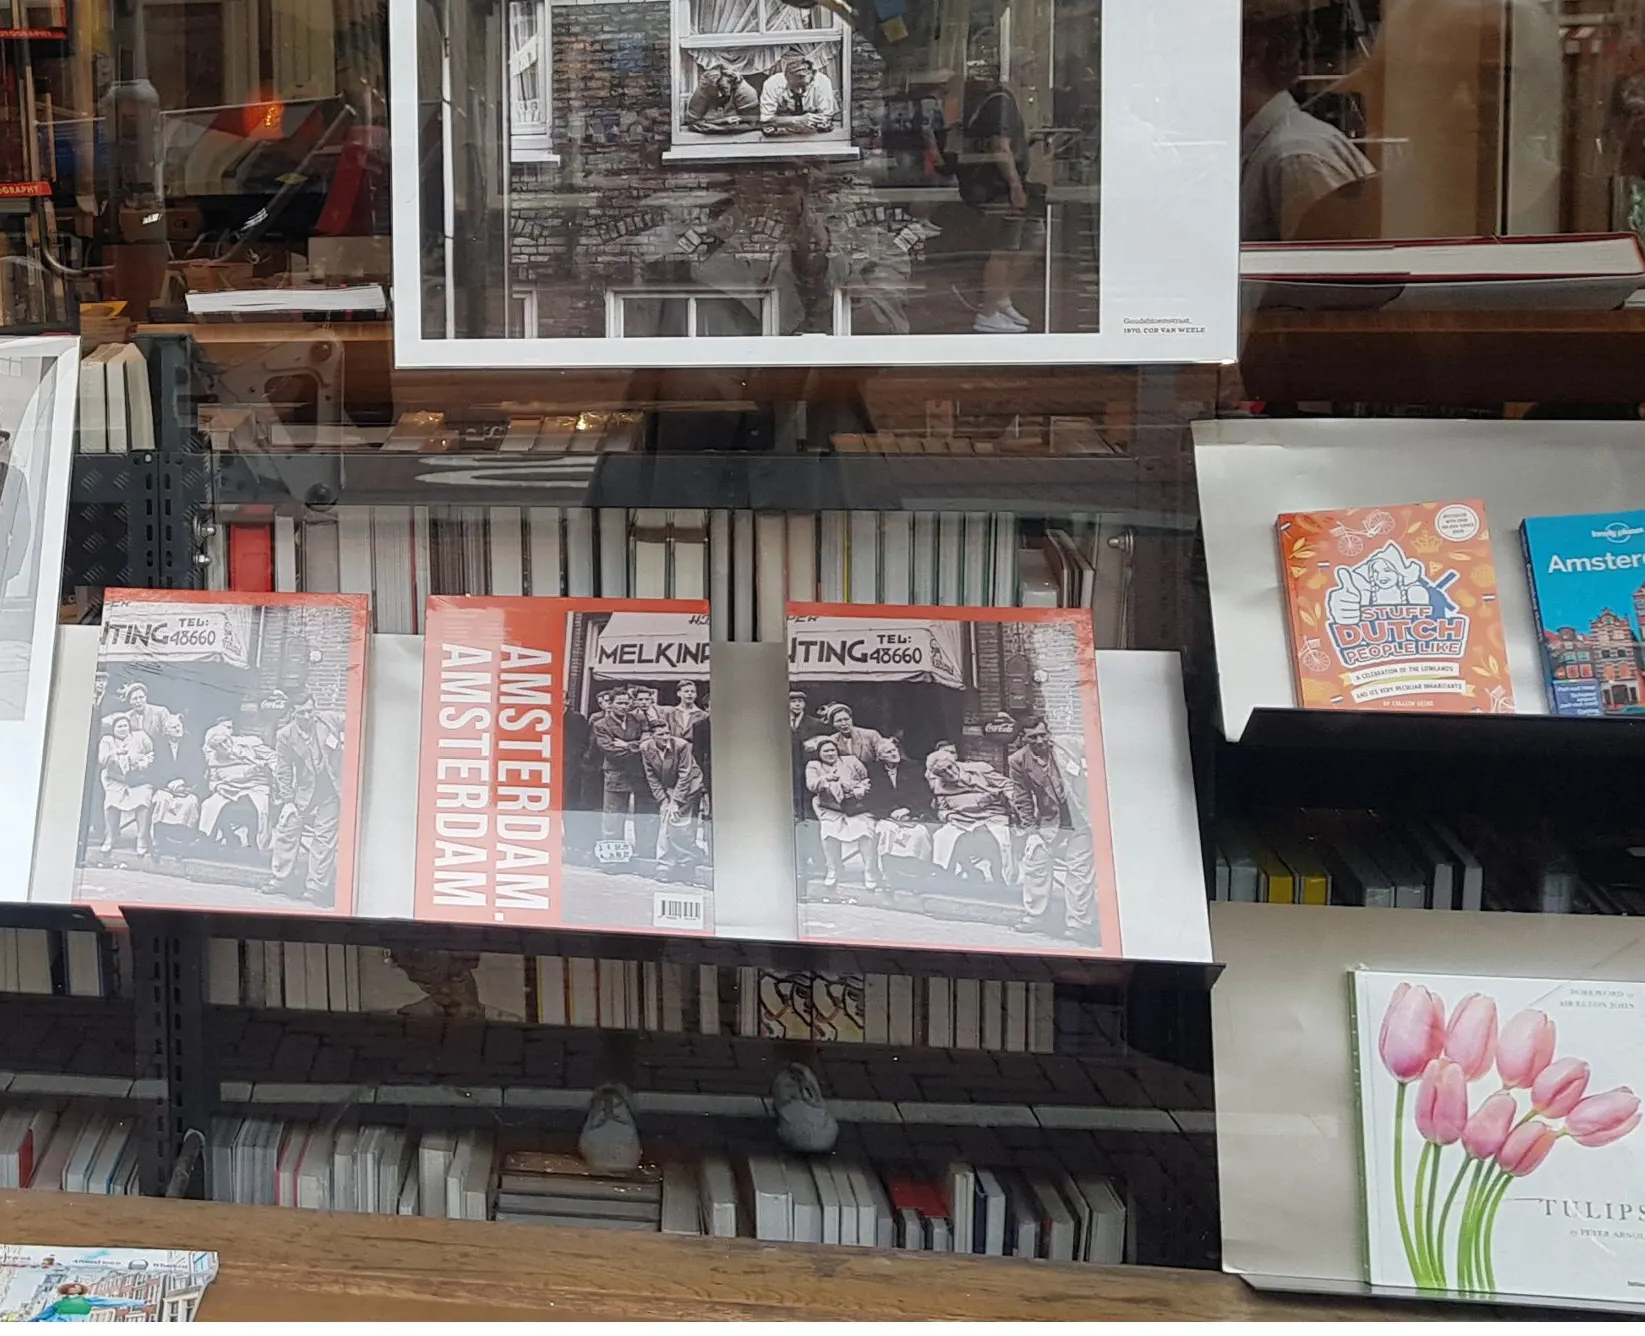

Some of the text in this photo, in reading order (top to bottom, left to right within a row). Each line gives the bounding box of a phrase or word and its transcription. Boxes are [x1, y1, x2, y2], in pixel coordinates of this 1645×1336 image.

[1360, 606, 1433, 620] STUFF
[178, 617, 210, 628] TEL:
[168, 629, 217, 646] 48660
[876, 634, 913, 646] TEL:
[1332, 618, 1465, 647] DUTCH
[868, 647, 924, 666] 48660
[1345, 641, 1461, 665] PEOPLE LIKE
[1361, 668, 1398, 679] CELEBRATION
[432, 642, 493, 907] AMSTERDAM
